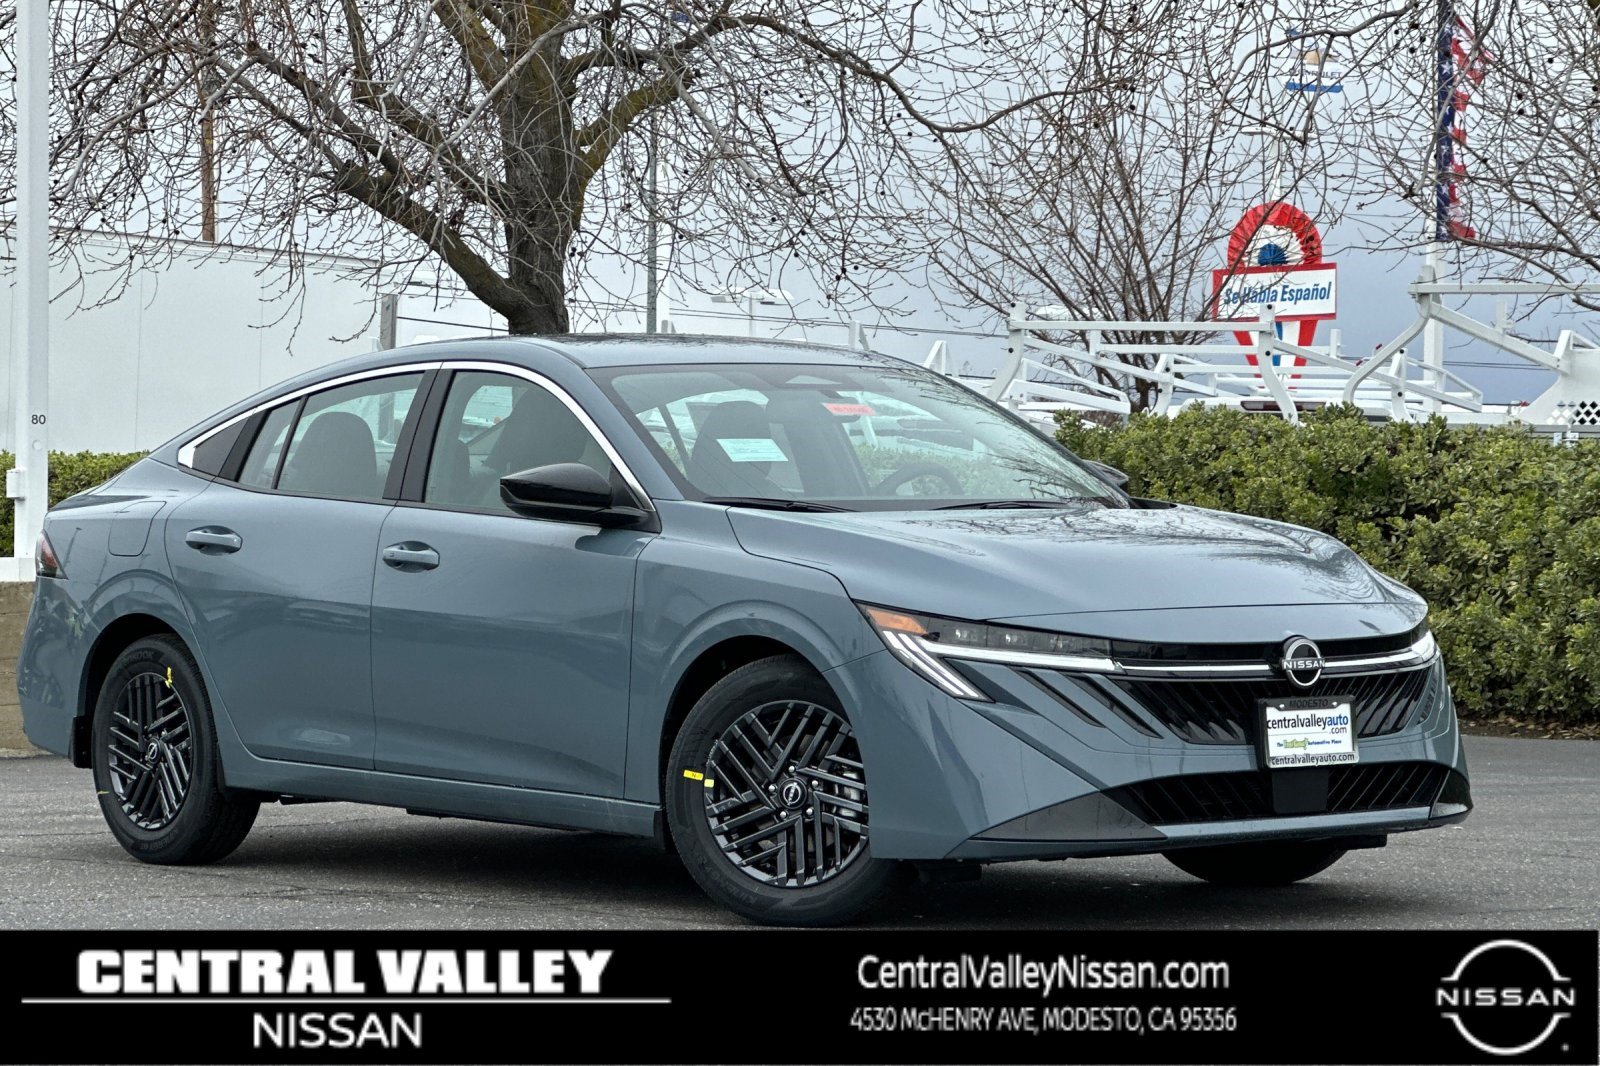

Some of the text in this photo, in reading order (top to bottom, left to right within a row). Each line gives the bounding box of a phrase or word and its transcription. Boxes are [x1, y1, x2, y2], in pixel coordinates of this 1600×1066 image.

[1224, 288, 1240, 304] Se
[1280, 281, 1332, 305] Español
[31, 414, 46, 425] 80
[1283, 660, 1325, 669] NISSAN
[1289, 699, 1328, 708] MODESTO
[1267, 714, 1349, 730] centralvalleyauto
[1329, 726, 1347, 734] .com
[1271, 753, 1355, 766] centralvalleyauto.com
